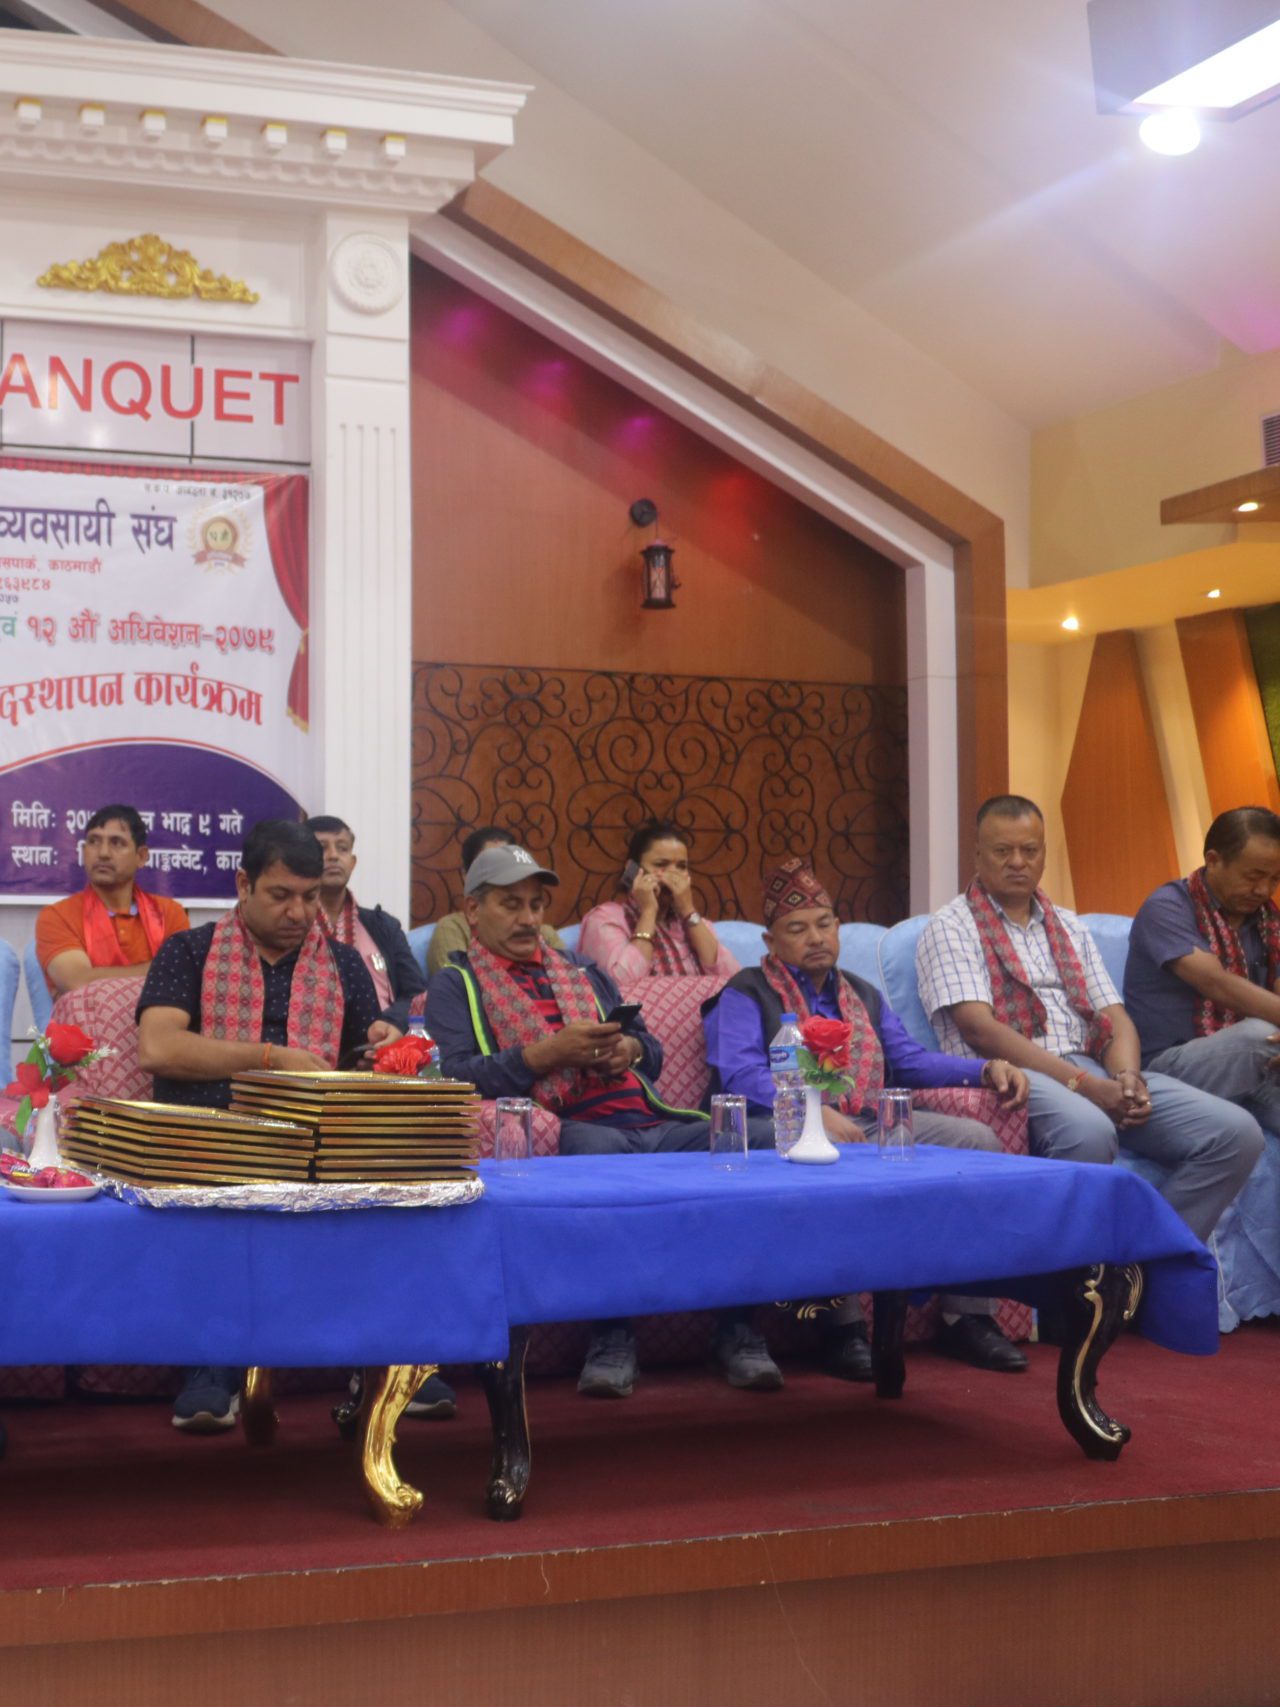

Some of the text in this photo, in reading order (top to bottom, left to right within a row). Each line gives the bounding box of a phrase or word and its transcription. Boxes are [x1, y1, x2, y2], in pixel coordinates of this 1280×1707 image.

[129, 504, 178, 554] संघ
[25, 613, 57, 646] १२
[134, 662, 263, 725] कार्यक्रम
[11, 801, 56, 829] मिति:
[161, 811, 192, 835] भाद्र
[198, 814, 211, 836] ९
[218, 808, 244, 834] गते
[11, 846, 58, 867] स्थान:
